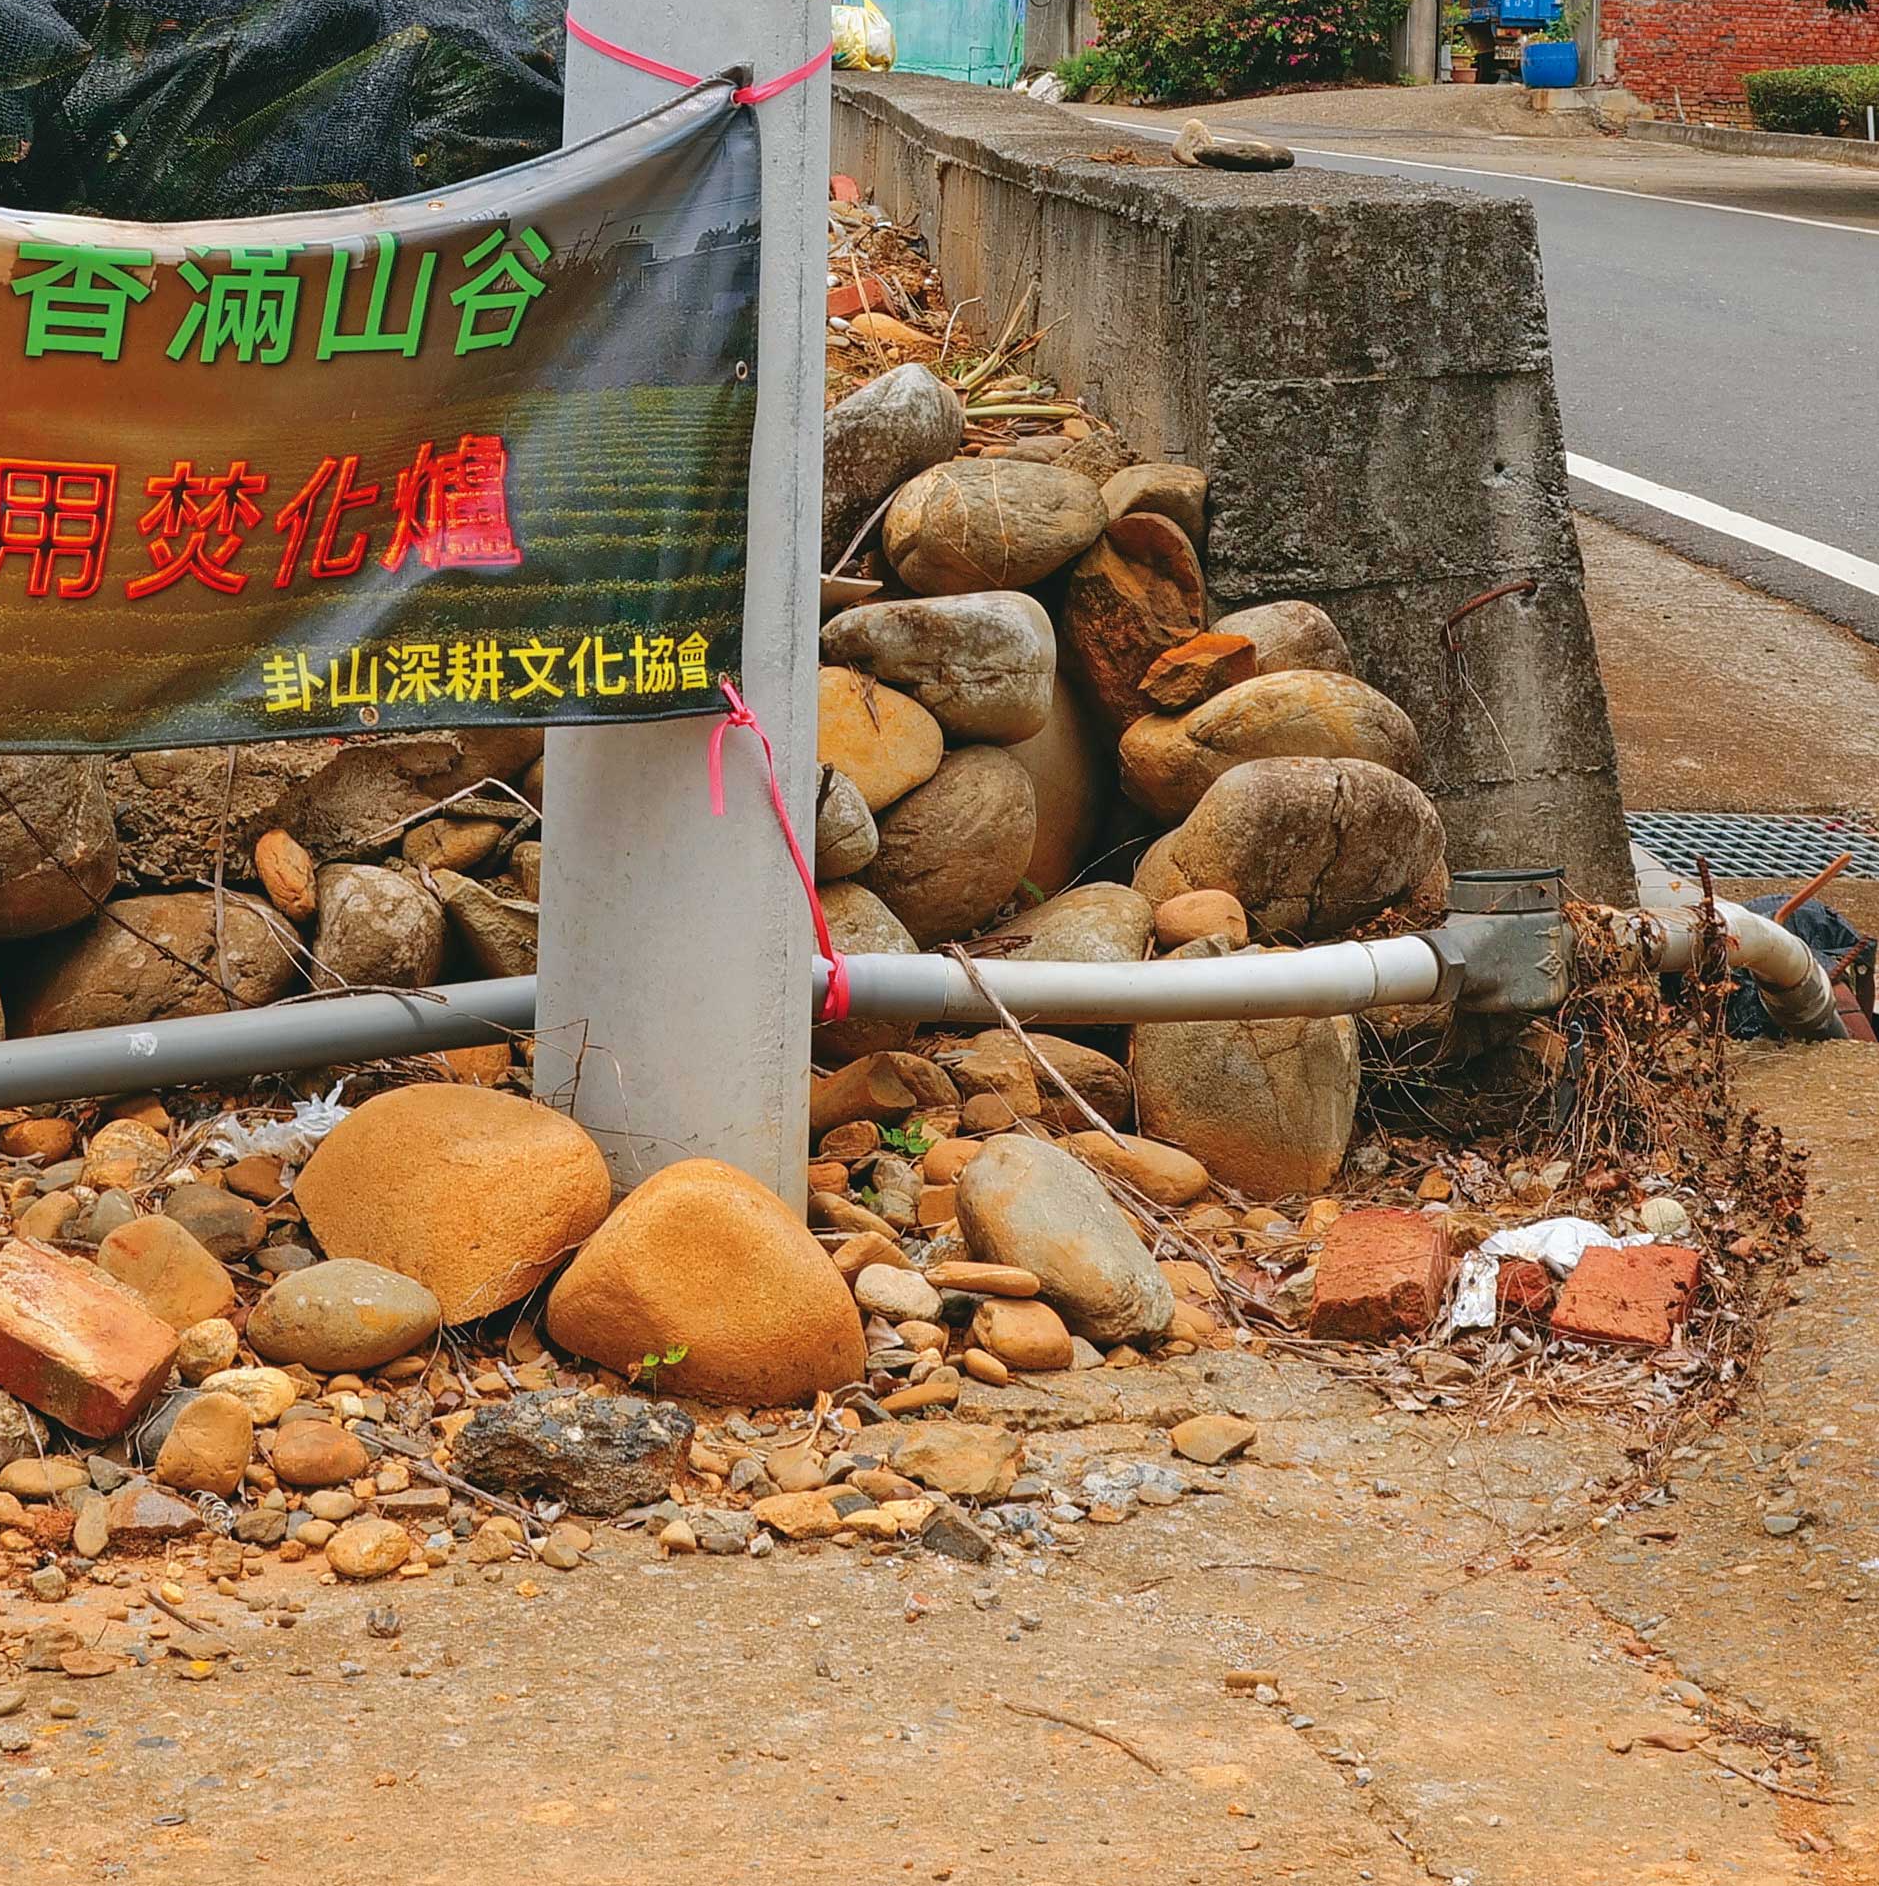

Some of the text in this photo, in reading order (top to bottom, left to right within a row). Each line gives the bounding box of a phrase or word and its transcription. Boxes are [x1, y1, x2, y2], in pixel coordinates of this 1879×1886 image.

[261, 630, 710, 713] 卦山深耕文化協會
